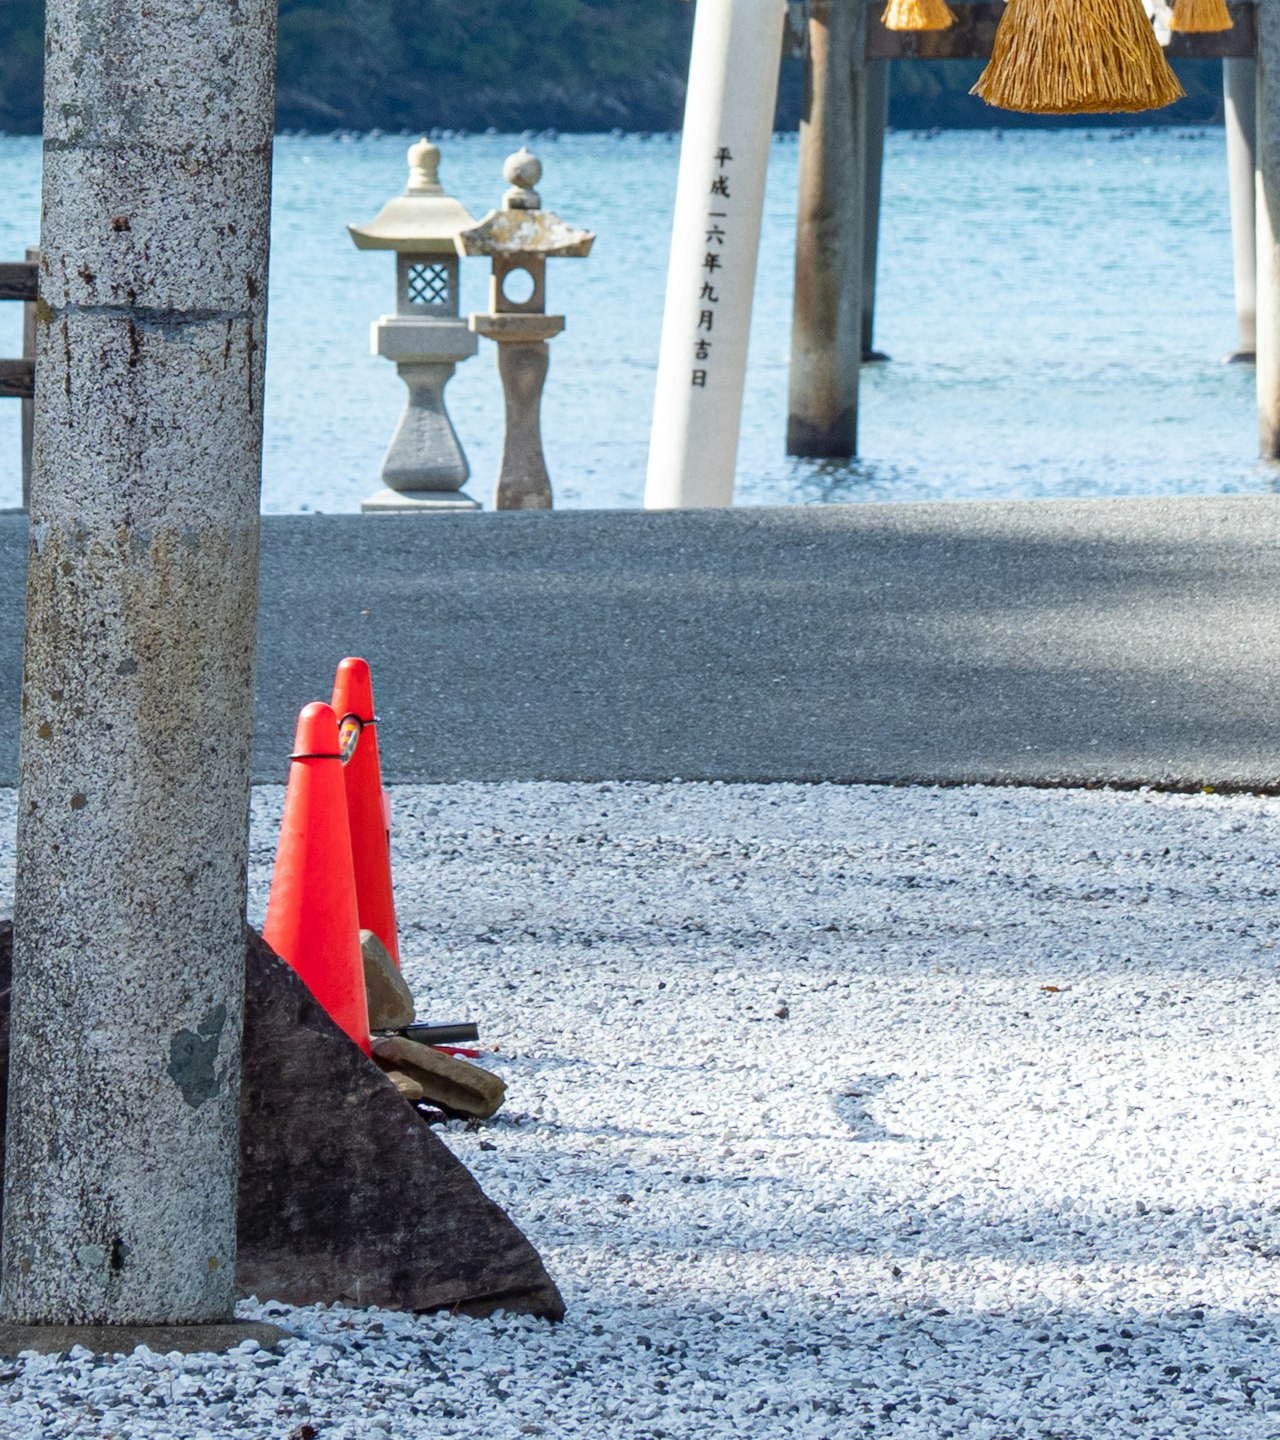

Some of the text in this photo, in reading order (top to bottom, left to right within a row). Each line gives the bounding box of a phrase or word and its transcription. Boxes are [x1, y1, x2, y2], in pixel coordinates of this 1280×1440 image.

[691, 146, 734, 388] 平成一六年九月吉日
